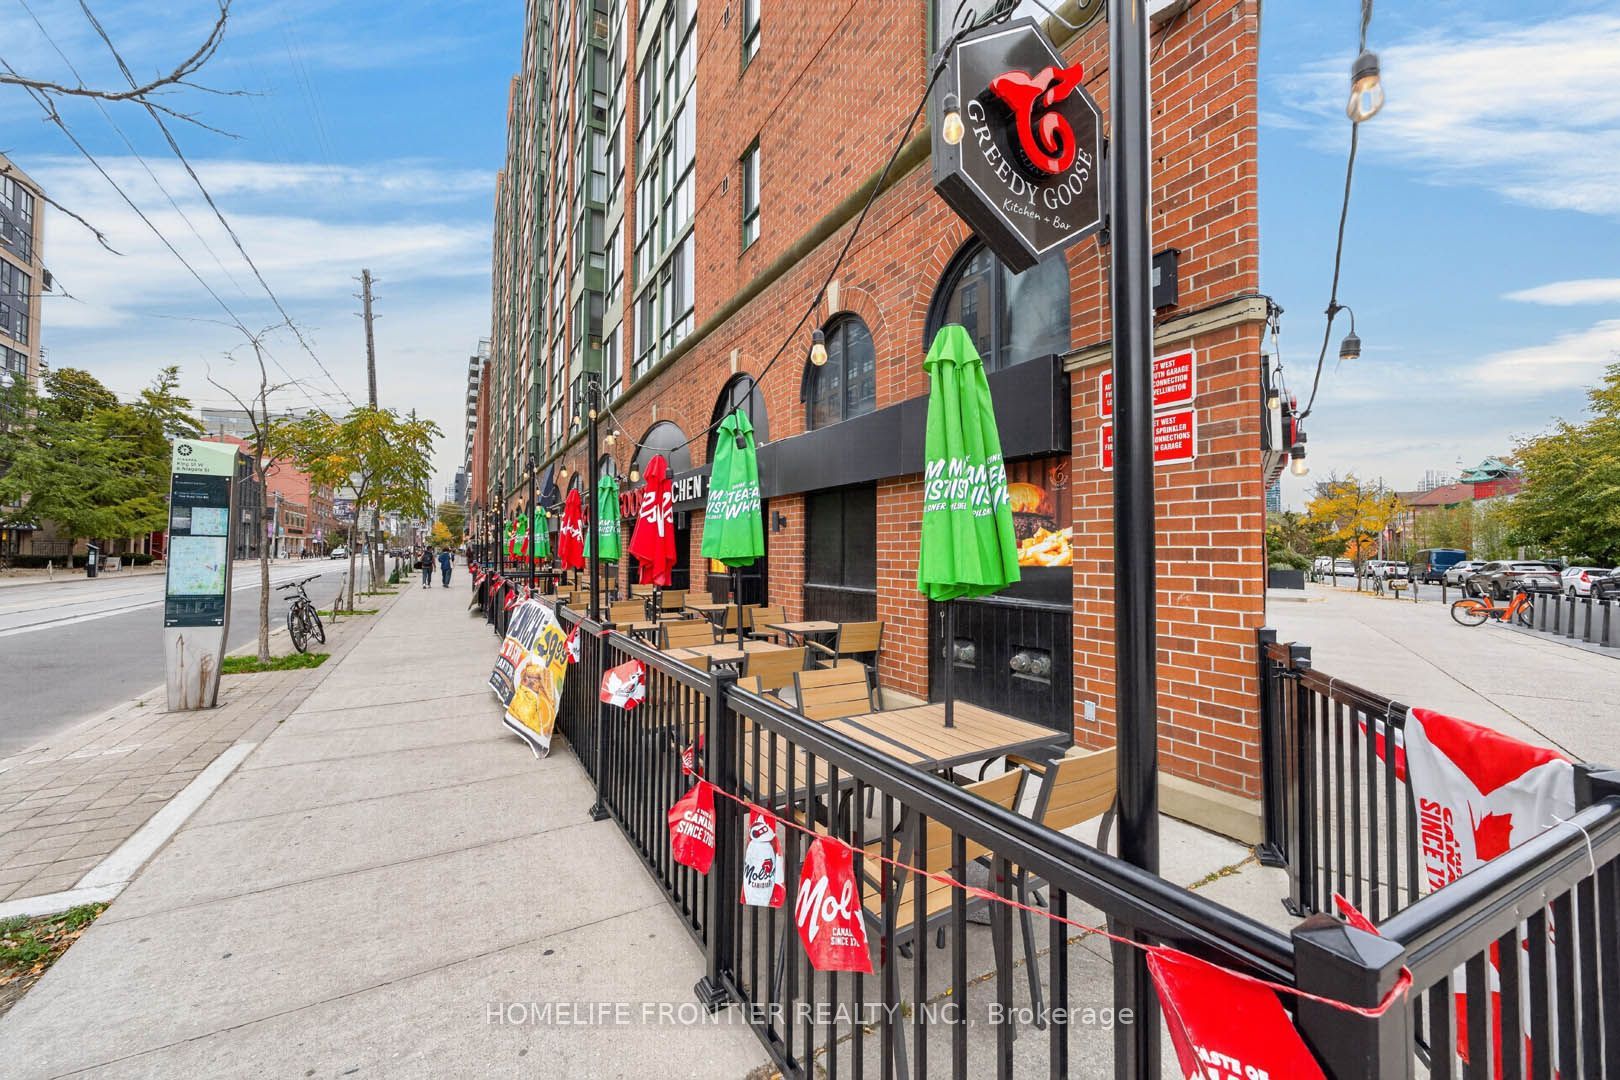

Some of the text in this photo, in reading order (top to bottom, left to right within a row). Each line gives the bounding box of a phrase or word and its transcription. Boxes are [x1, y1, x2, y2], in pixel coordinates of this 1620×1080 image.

[967, 100, 1092, 210] GREEDY GOOSE
[1002, 198, 1041, 221] Kitchen
[1052, 215, 1071, 231] Bar
[1155, 432, 1190, 443] ONNECTIONS
[671, 474, 702, 503] CHEN
[676, 820, 703, 841] SINCE
[1420, 797, 1444, 863] SINCE
[795, 875, 853, 944] Mol
[831, 936, 849, 946] SINCE
